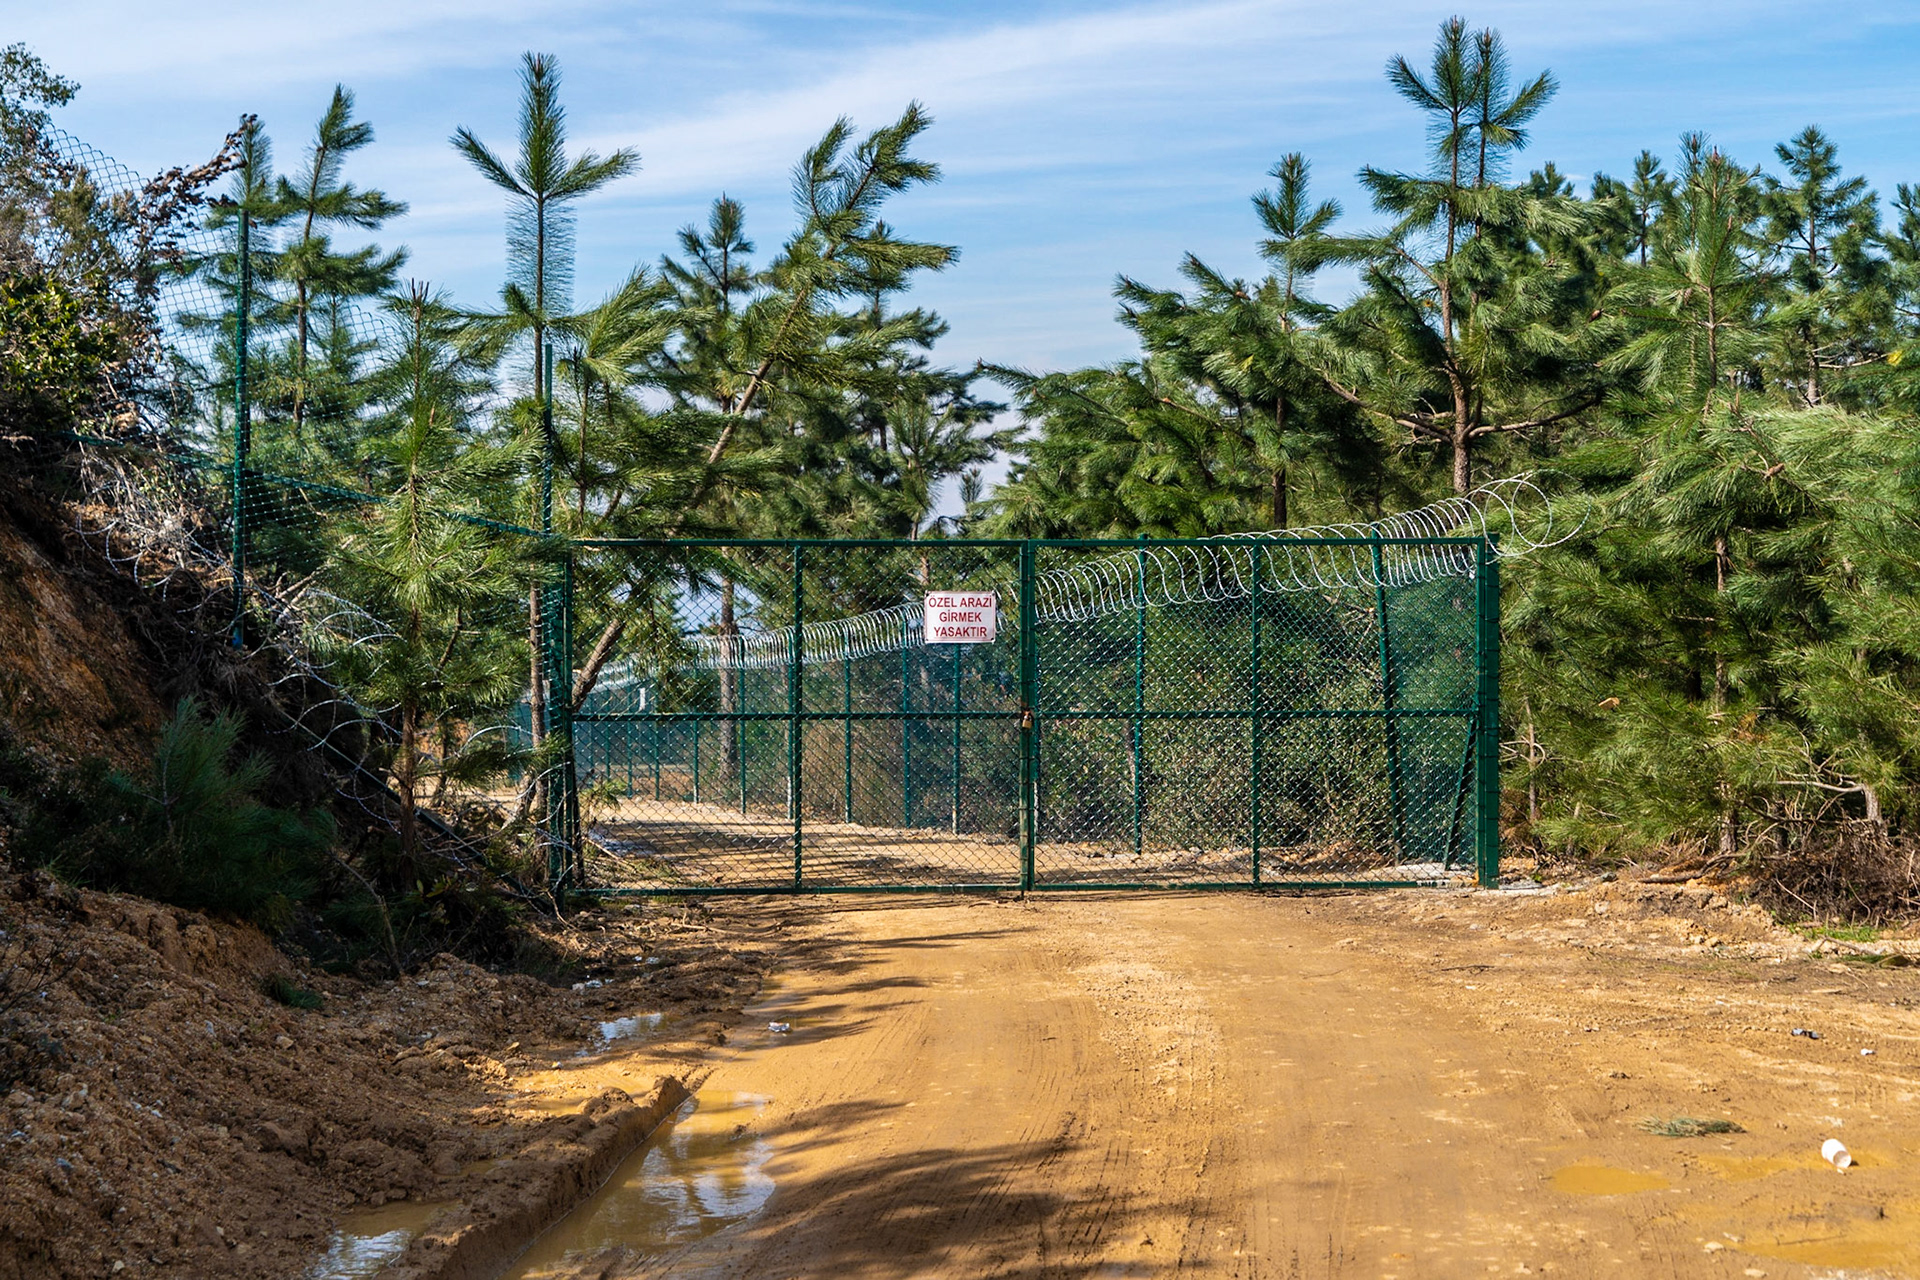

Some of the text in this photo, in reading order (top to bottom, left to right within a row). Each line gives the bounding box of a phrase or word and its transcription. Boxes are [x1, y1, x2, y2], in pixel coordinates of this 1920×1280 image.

[928, 595, 992, 608] ÖZEL ARAZİ
[939, 610, 982, 622] GİRMEK
[934, 626, 987, 637] YASAKTIR
